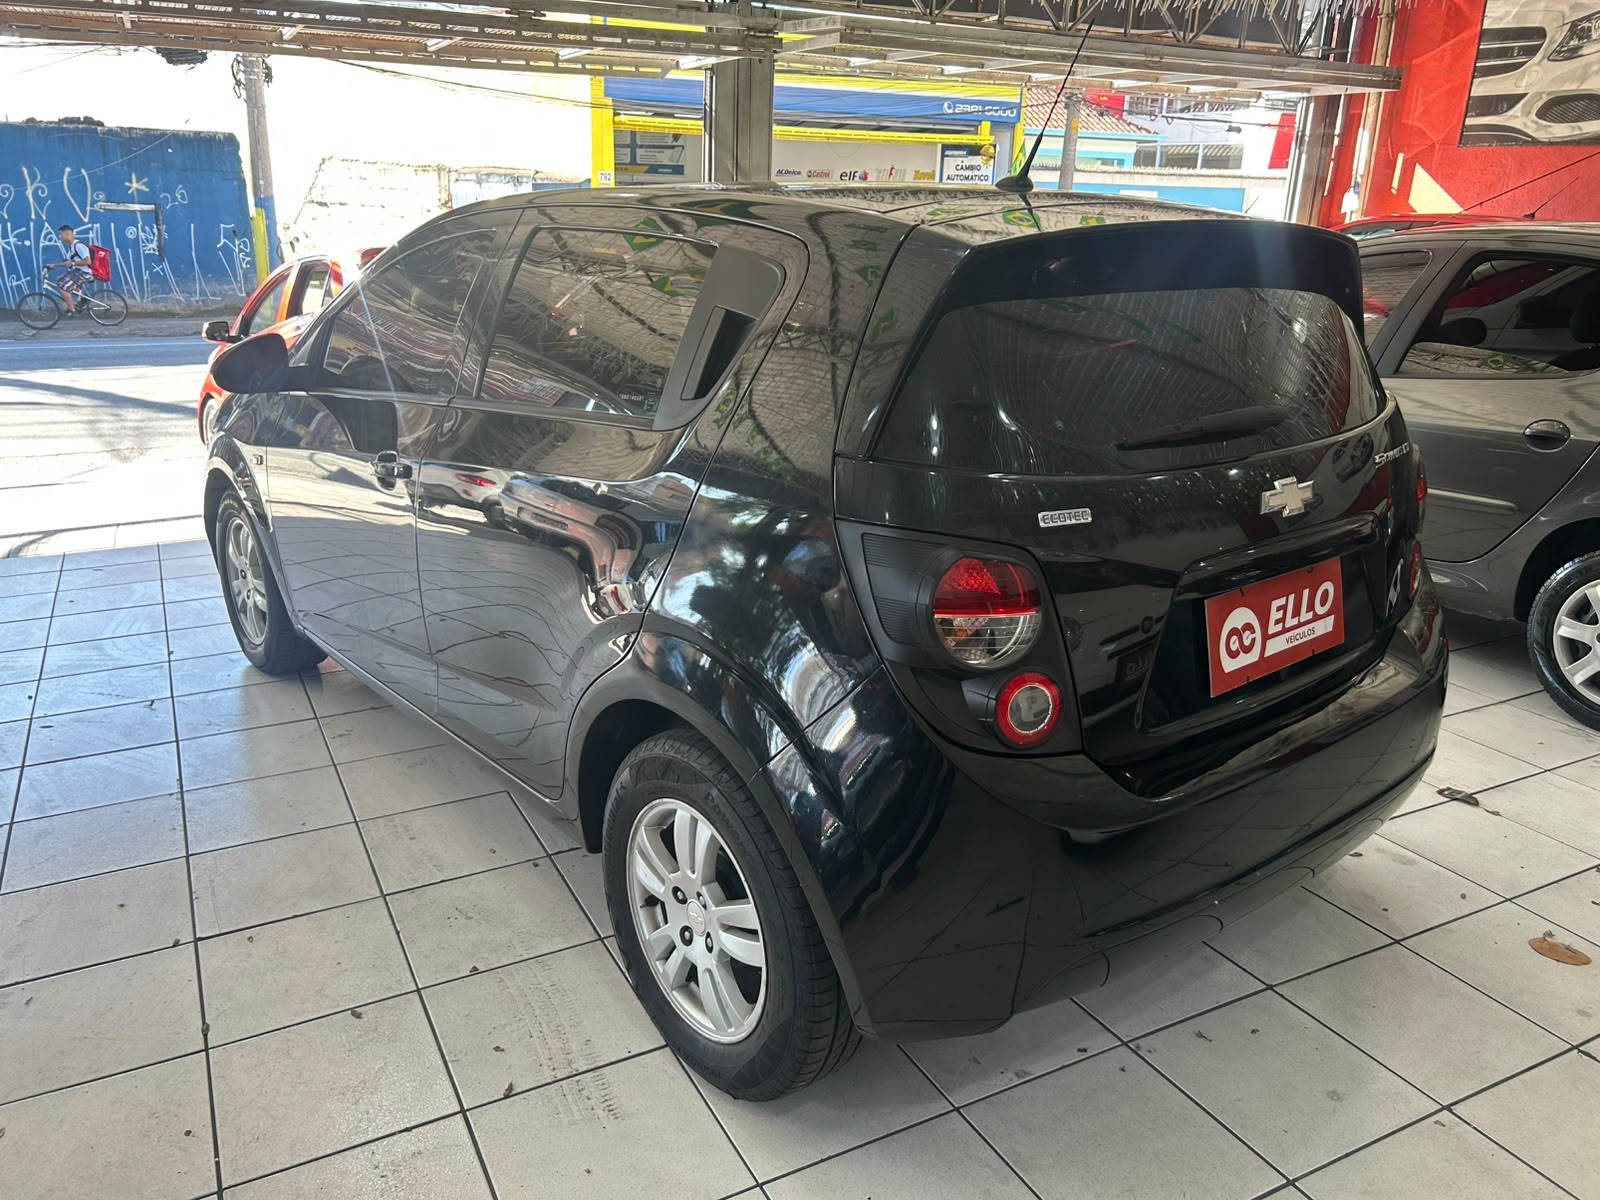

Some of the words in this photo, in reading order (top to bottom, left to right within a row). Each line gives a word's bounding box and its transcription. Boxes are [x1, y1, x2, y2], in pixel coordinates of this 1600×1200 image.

[600, 172, 612, 182] 792
[840, 171, 859, 181] elf
[946, 171, 990, 182] AUTOMÁTICO
[1041, 509, 1090, 525] ECOTEC
[1267, 580, 1334, 635] ELLO
[1285, 626, 1316, 645] VEÍCULOS
